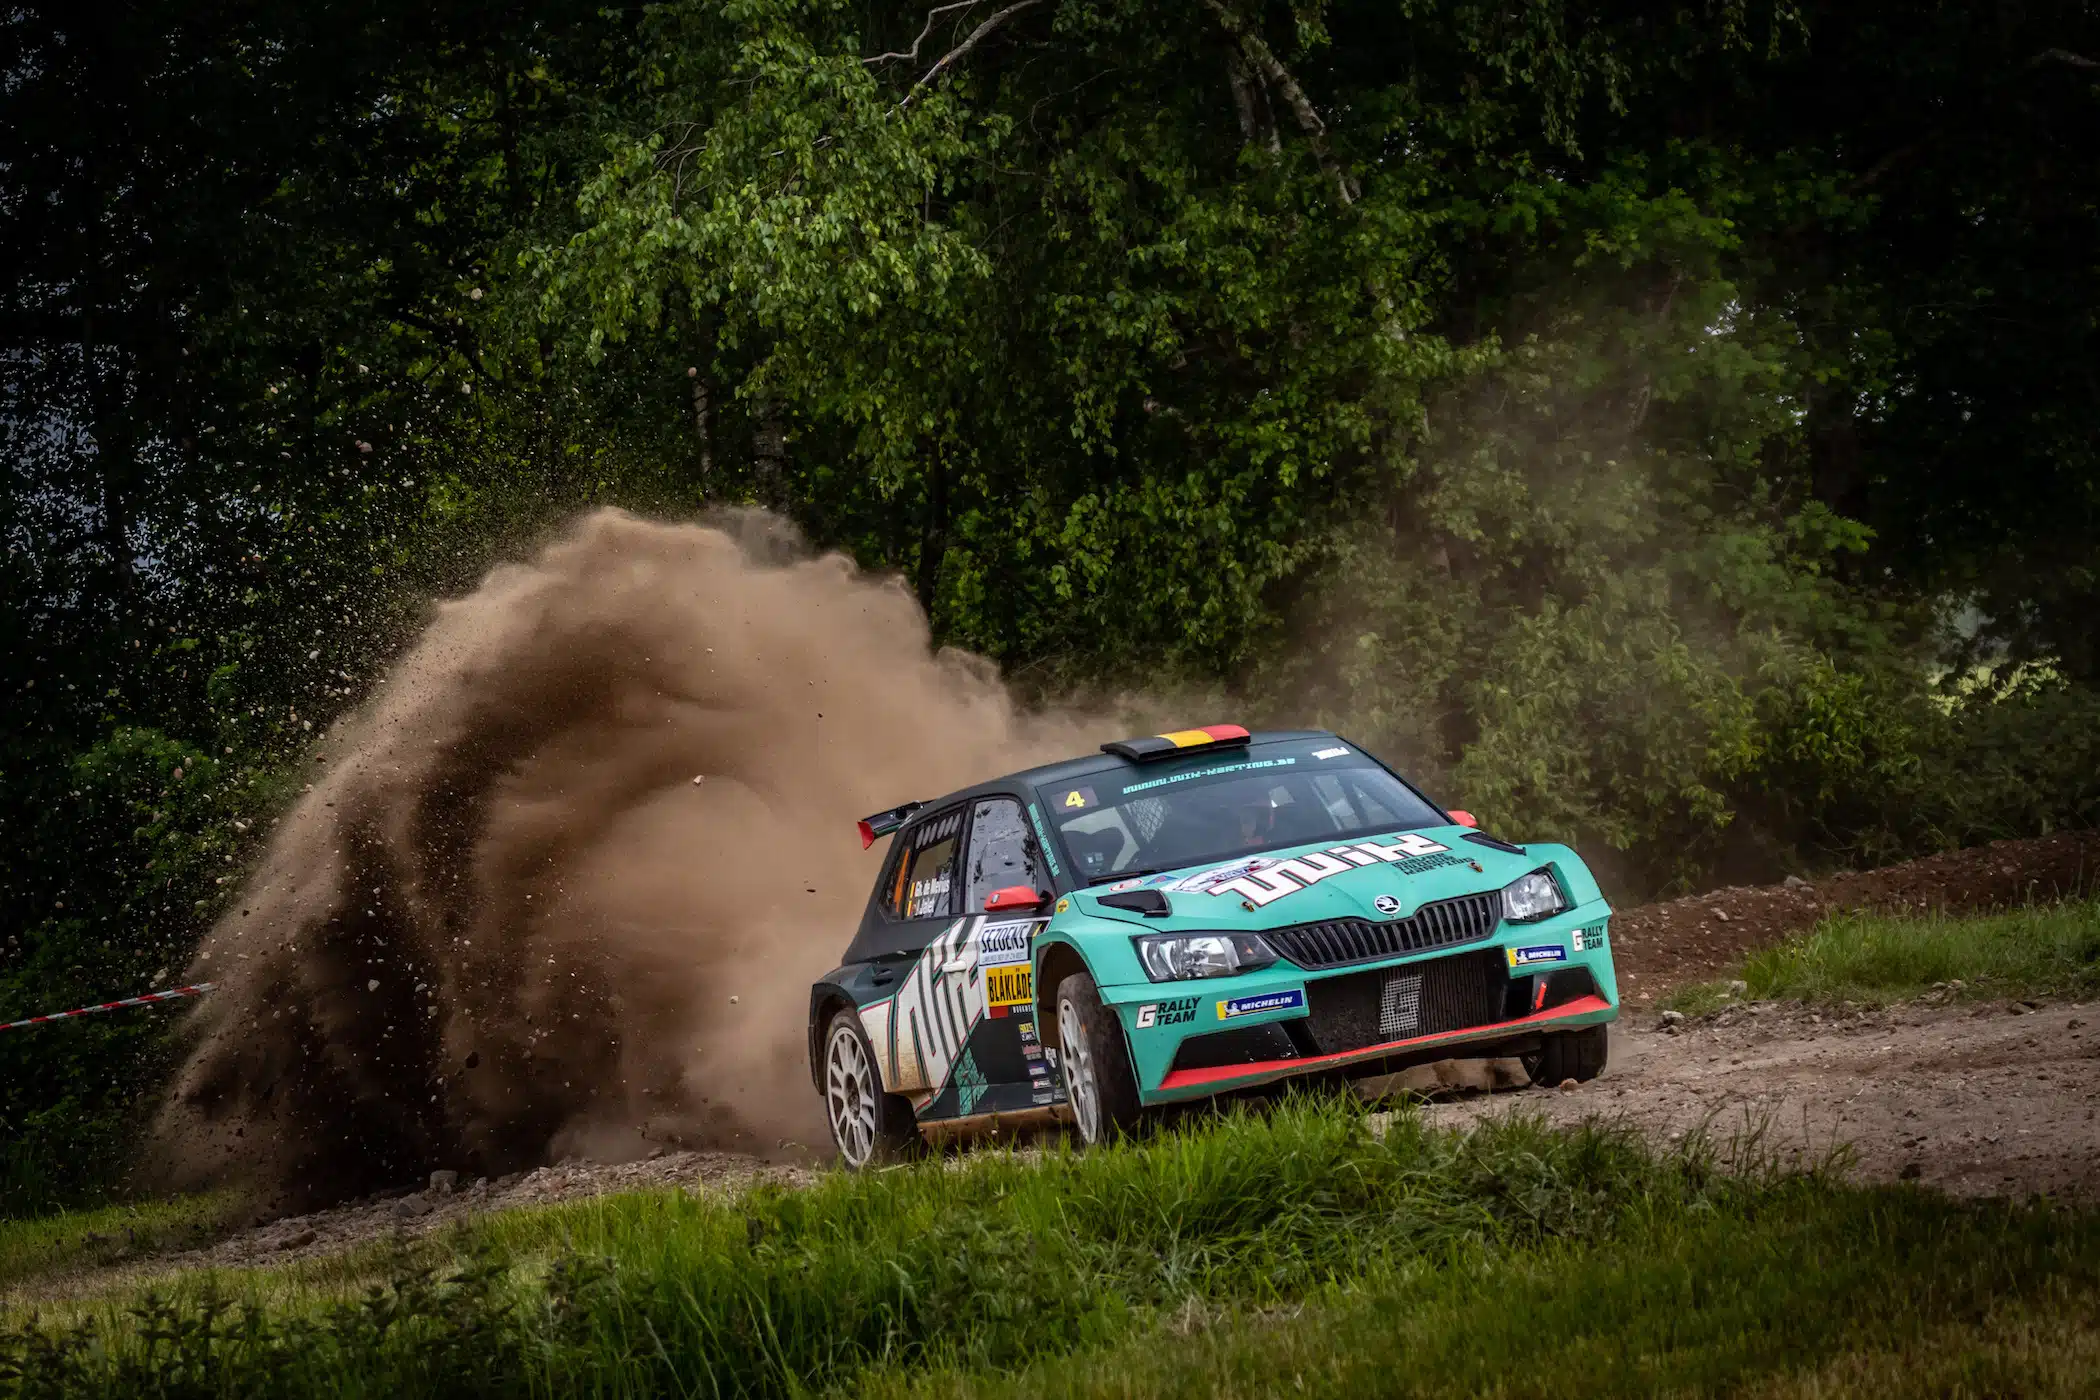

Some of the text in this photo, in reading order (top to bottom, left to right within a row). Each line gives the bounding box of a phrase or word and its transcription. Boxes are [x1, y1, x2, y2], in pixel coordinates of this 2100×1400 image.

[1065, 791, 1085, 807] 4
[982, 924, 1029, 953] SEZOENS
[1582, 924, 1604, 938] RALLY
[1582, 937, 1604, 950] TEAM
[1528, 950, 1562, 959] MICHELIN
[988, 966, 1032, 1003] BLÅKLÄDE
[1012, 1005, 1033, 1015] WORKWE
[1158, 997, 1202, 1014] RALLY
[1240, 995, 1293, 1011] MICHELIN
[1157, 1009, 1197, 1026] TEAM
